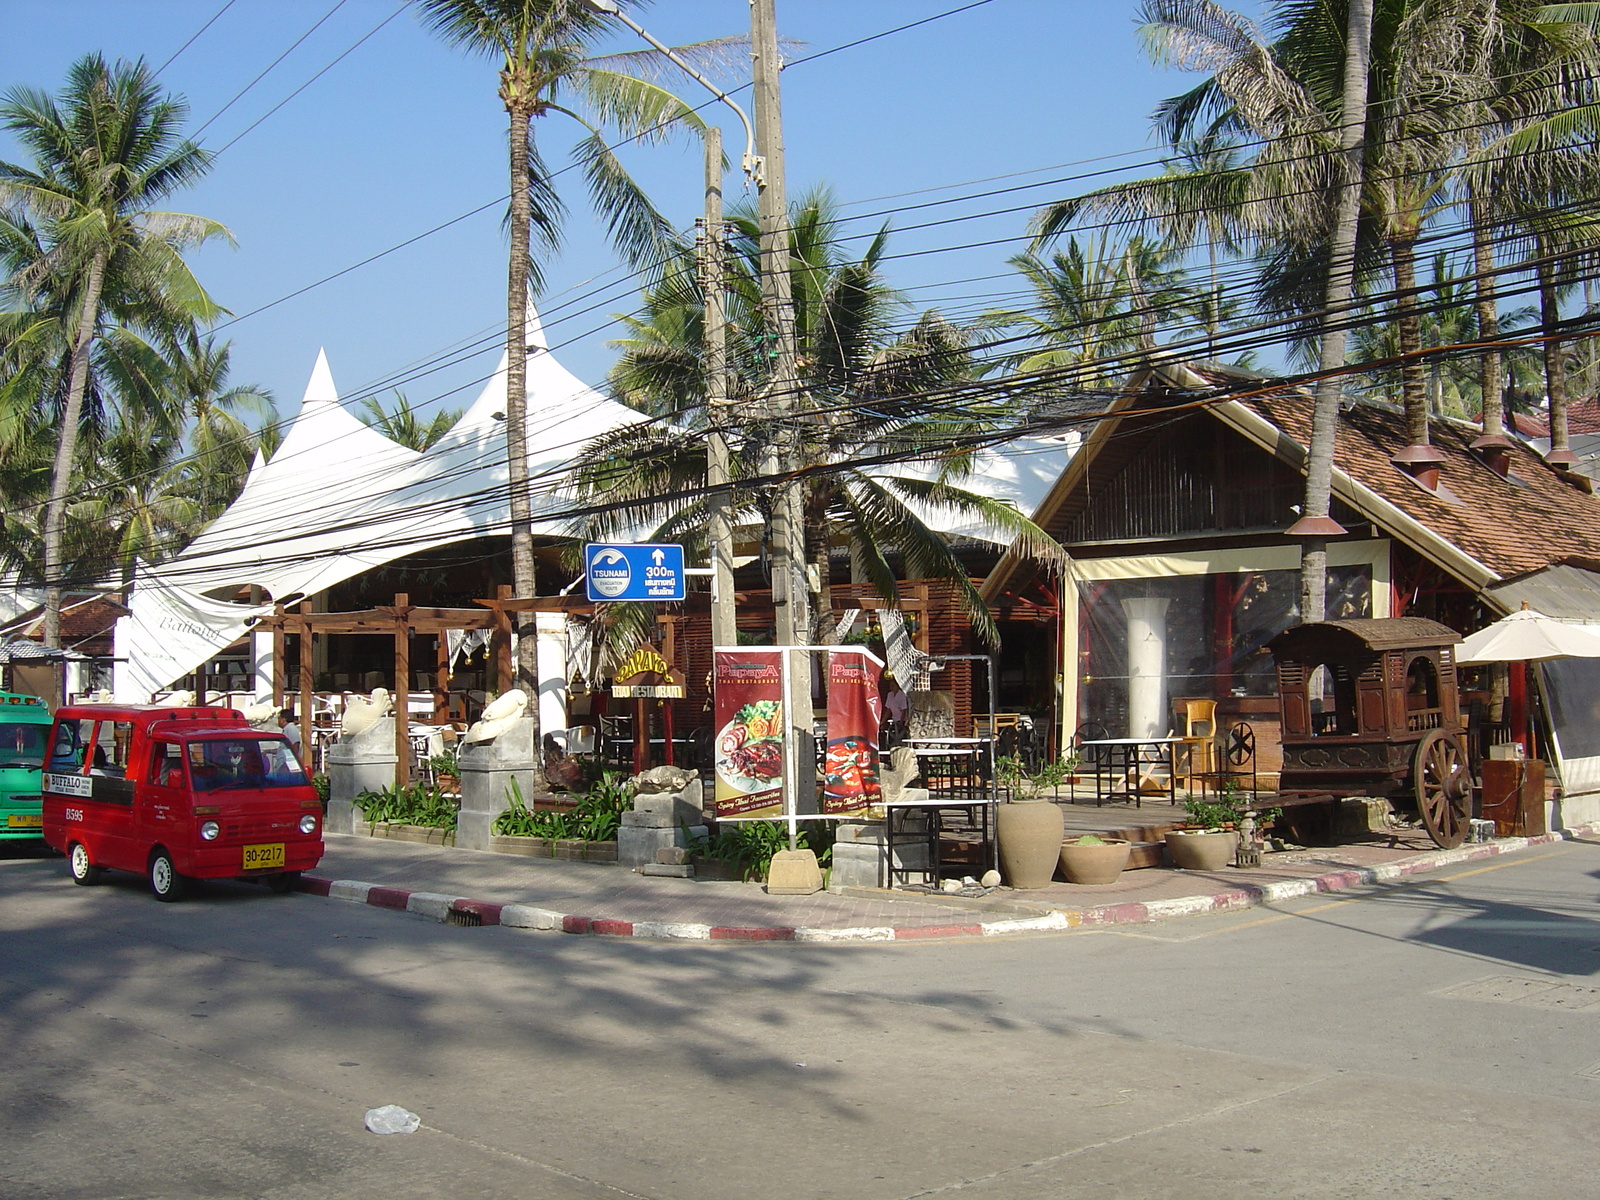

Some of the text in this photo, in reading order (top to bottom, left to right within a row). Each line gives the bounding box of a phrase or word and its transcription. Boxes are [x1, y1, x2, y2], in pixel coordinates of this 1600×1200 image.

[594, 570, 628, 578] TSUNAMI
[645, 567, 675, 578] 300m
[615, 649, 674, 684] PAPAYA
[611, 685, 683, 699] THAI RESTAURANT
[51, 775, 81, 788] BUFFALO
[717, 791, 780, 810] Spicy Thai Favourites
[826, 800, 843, 808] Spicy
[843, 796, 858, 806] Thai
[65, 808, 84, 822] B595
[245, 848, 283, 863] 30-2217
